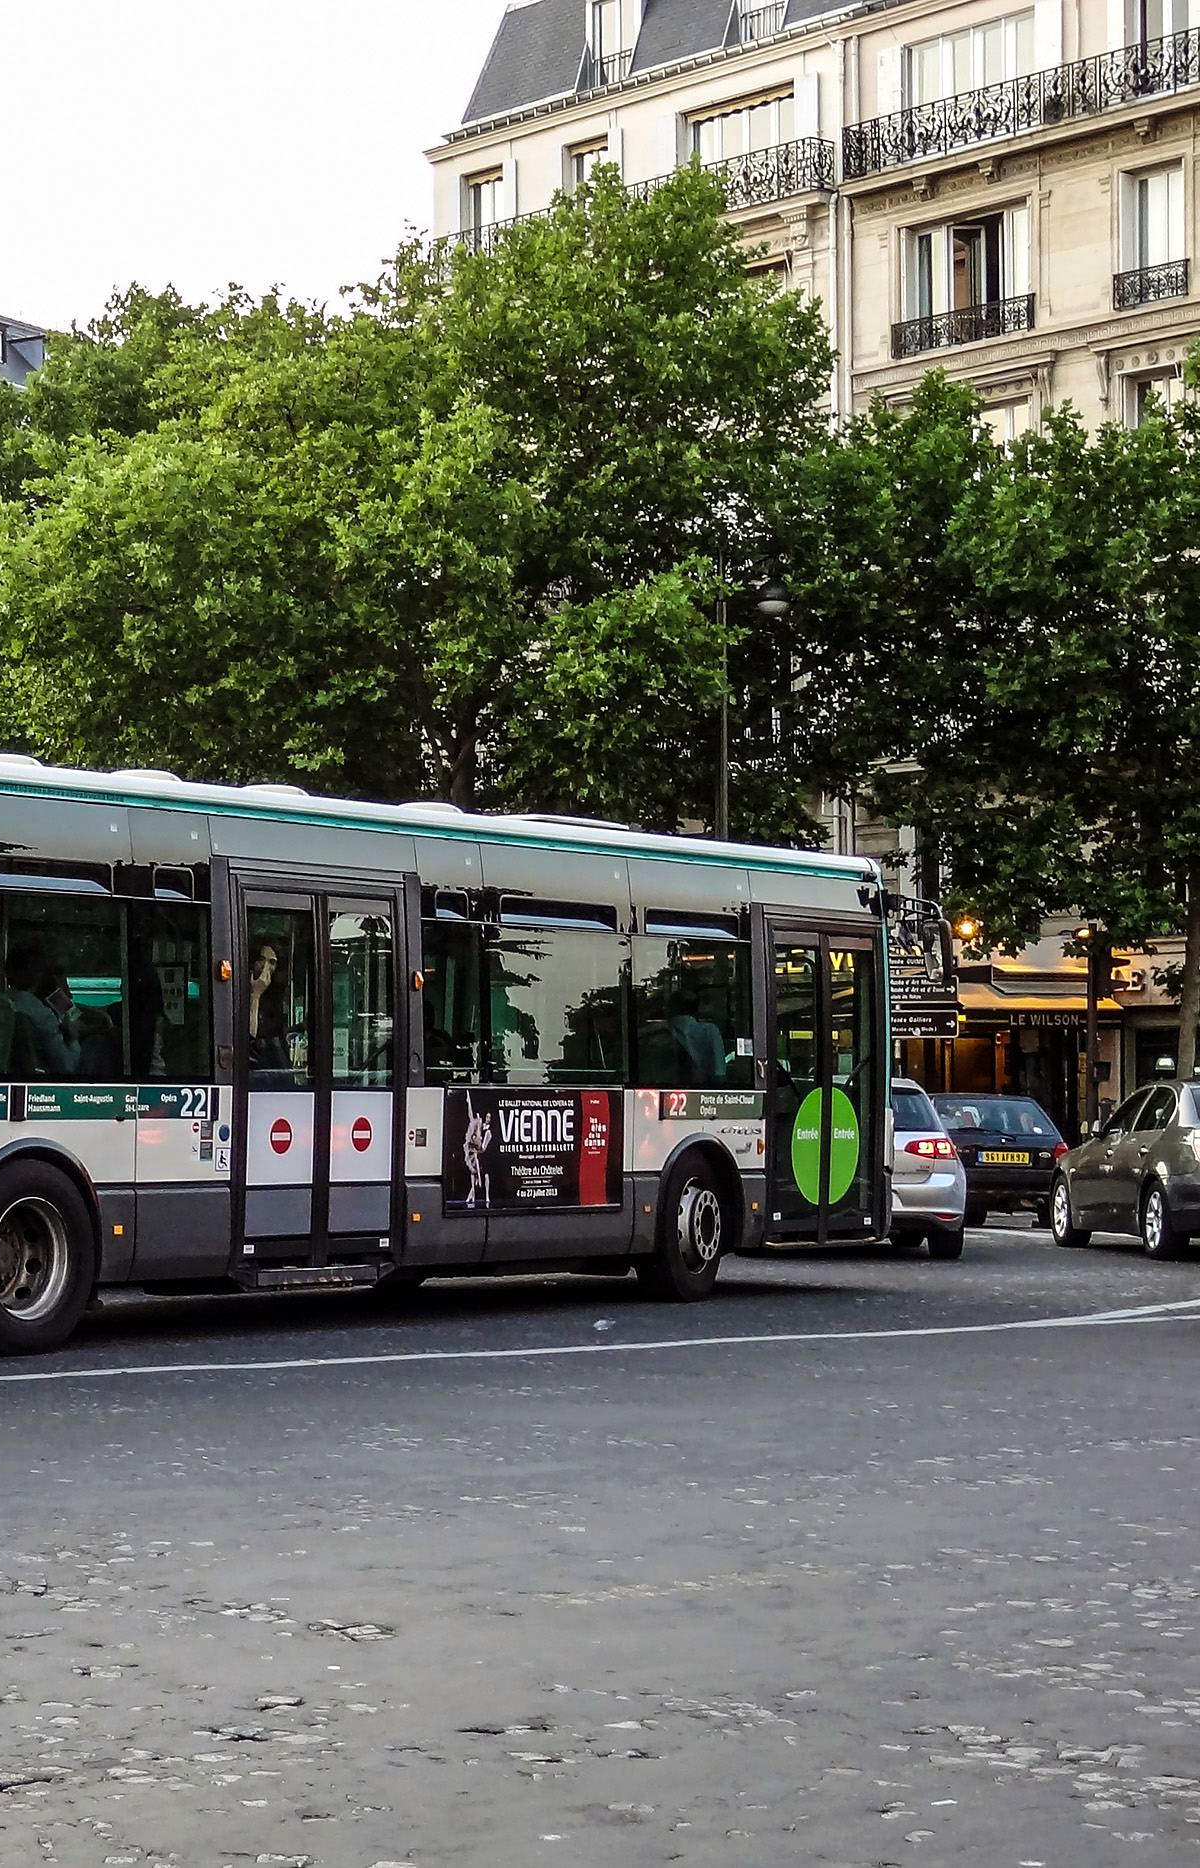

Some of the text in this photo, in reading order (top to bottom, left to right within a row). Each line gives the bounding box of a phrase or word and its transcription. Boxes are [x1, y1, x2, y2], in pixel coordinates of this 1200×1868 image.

[1010, 1014, 1079, 1026] LE WILSON
[28, 1094, 56, 1103] Friedland
[73, 1094, 114, 1105] Saint-Augustin
[160, 1094, 178, 1103] Opéra
[180, 1088, 207, 1117] 22
[700, 1094, 755, 1105] Porte de Saint-Cloud
[28, 1104, 61, 1112] Haussmann
[669, 1092, 687, 1117] 22
[700, 1105, 717, 1116] Opéra
[797, 1128, 818, 1140] Entrée
[833, 1128, 855, 1140] Entrée
